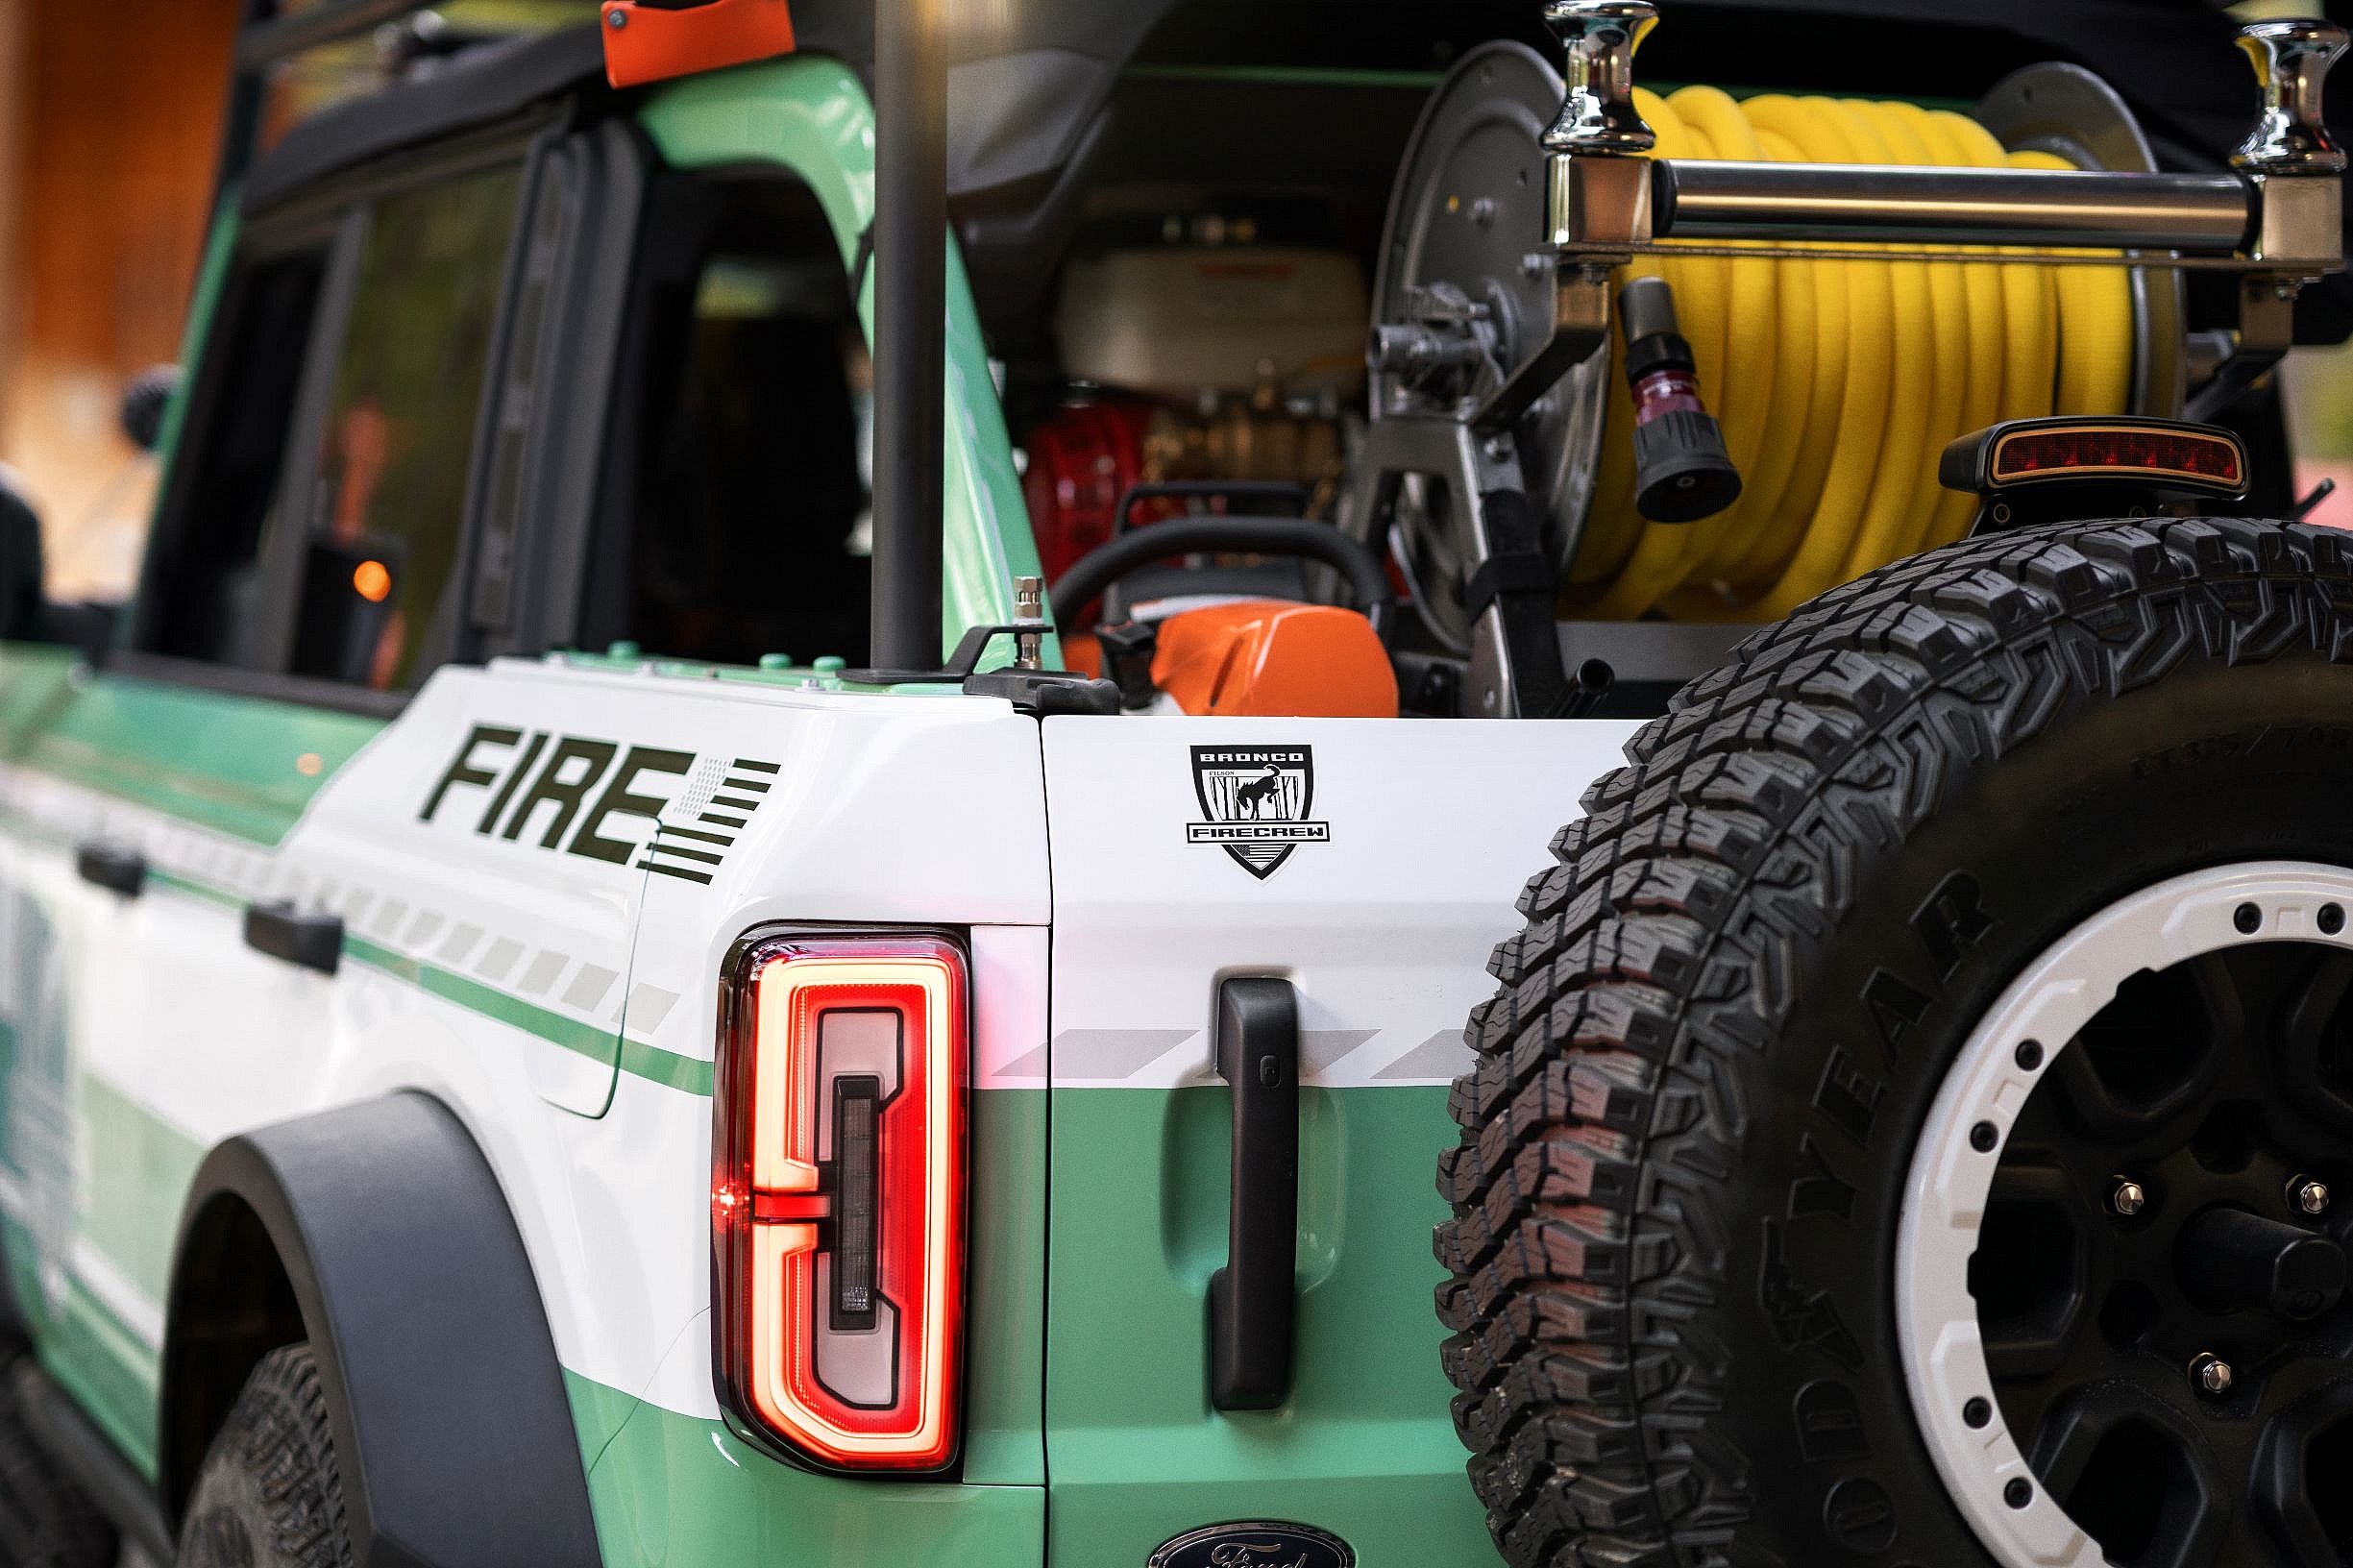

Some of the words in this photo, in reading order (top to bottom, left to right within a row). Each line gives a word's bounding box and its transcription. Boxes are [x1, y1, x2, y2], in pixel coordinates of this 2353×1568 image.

[1199, 752, 1305, 763] BRONCO
[418, 724, 698, 866] FIRE
[1192, 826, 1325, 839] FIRECREW
[1788, 868, 2001, 1568] ODYEAR
[1205, 1542, 1309, 1568] Fd
